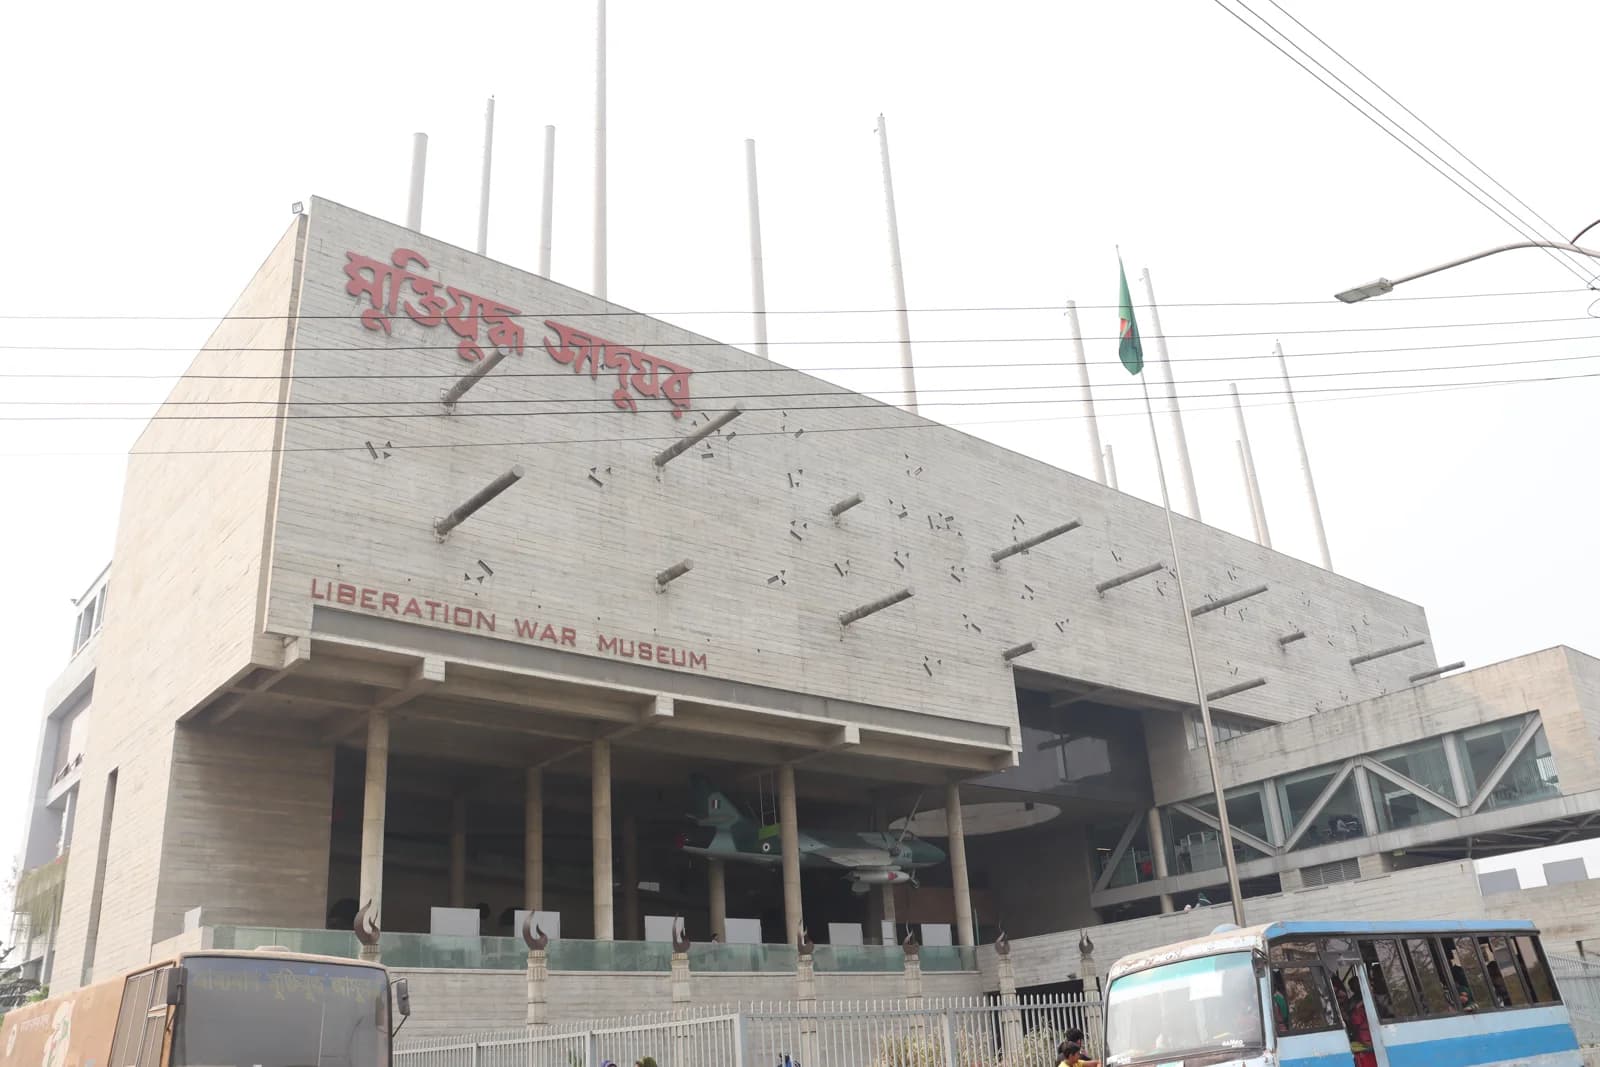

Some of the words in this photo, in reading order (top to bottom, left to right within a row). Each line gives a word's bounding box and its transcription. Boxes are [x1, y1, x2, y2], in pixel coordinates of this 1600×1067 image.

[344, 248, 525, 361] মুক্তিযুদ্ধ
[544, 320, 693, 419] জাদুঘর
[311, 578, 496, 632] LIBERATION
[514, 618, 577, 646] WAR
[598, 633, 708, 671] MUSEUM
